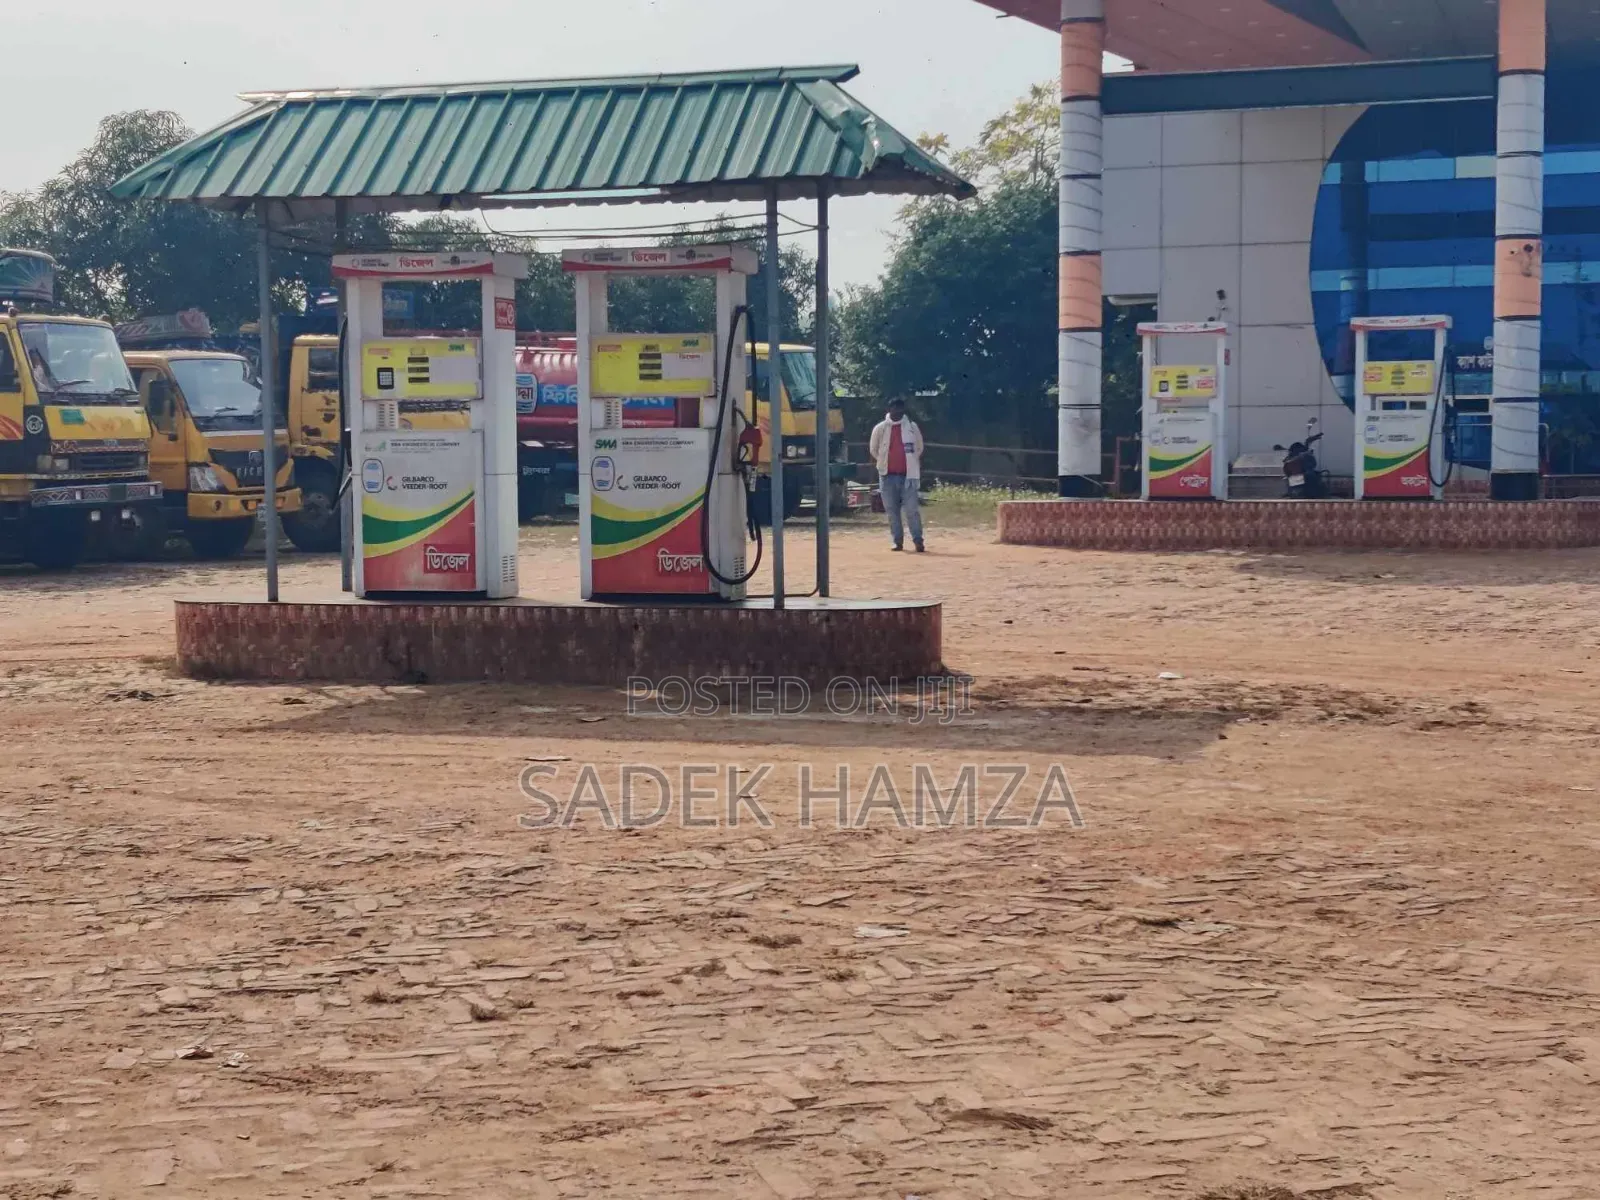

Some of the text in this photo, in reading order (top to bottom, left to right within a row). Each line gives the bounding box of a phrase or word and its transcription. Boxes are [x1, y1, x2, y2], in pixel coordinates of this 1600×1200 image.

[516, 387, 534, 400] দ্মা
[595, 439, 617, 450] SMA
[425, 546, 470, 571] ডিজেল
[657, 548, 703, 573] ডিজেল
